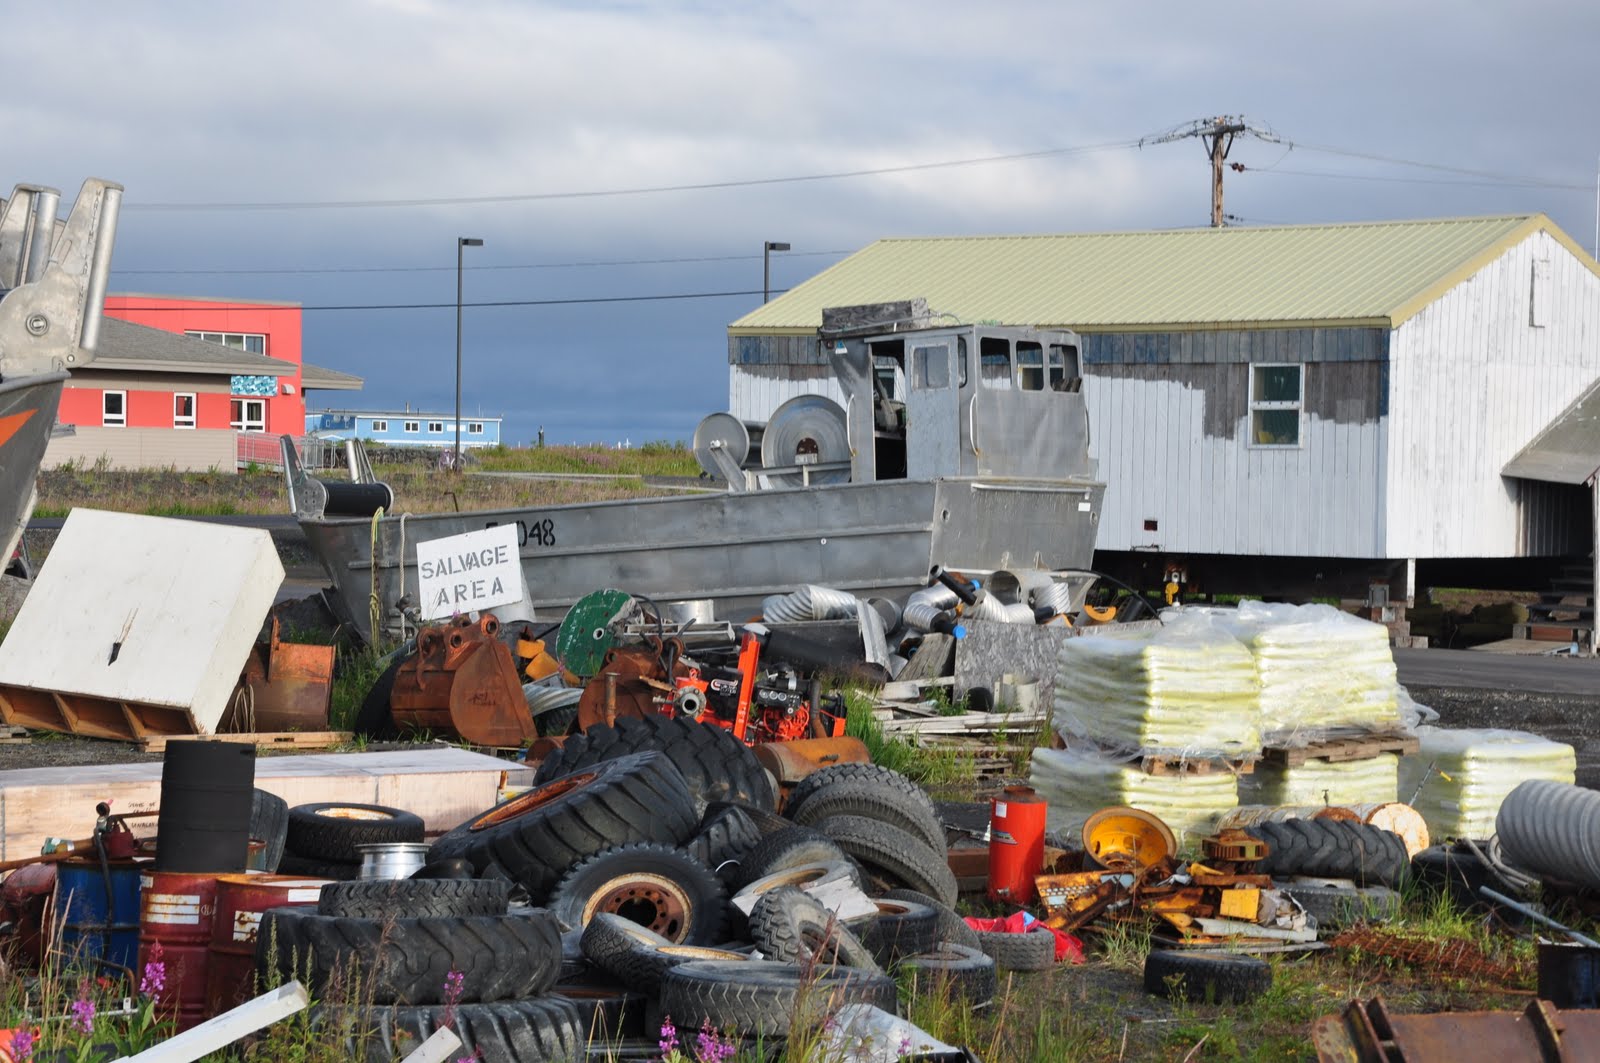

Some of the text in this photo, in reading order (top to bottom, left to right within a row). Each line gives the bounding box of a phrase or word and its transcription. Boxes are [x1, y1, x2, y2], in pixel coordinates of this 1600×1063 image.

[486, 519, 556, 547] 048
[421, 545, 509, 579] SALVAGE
[437, 577, 504, 606] AREA
